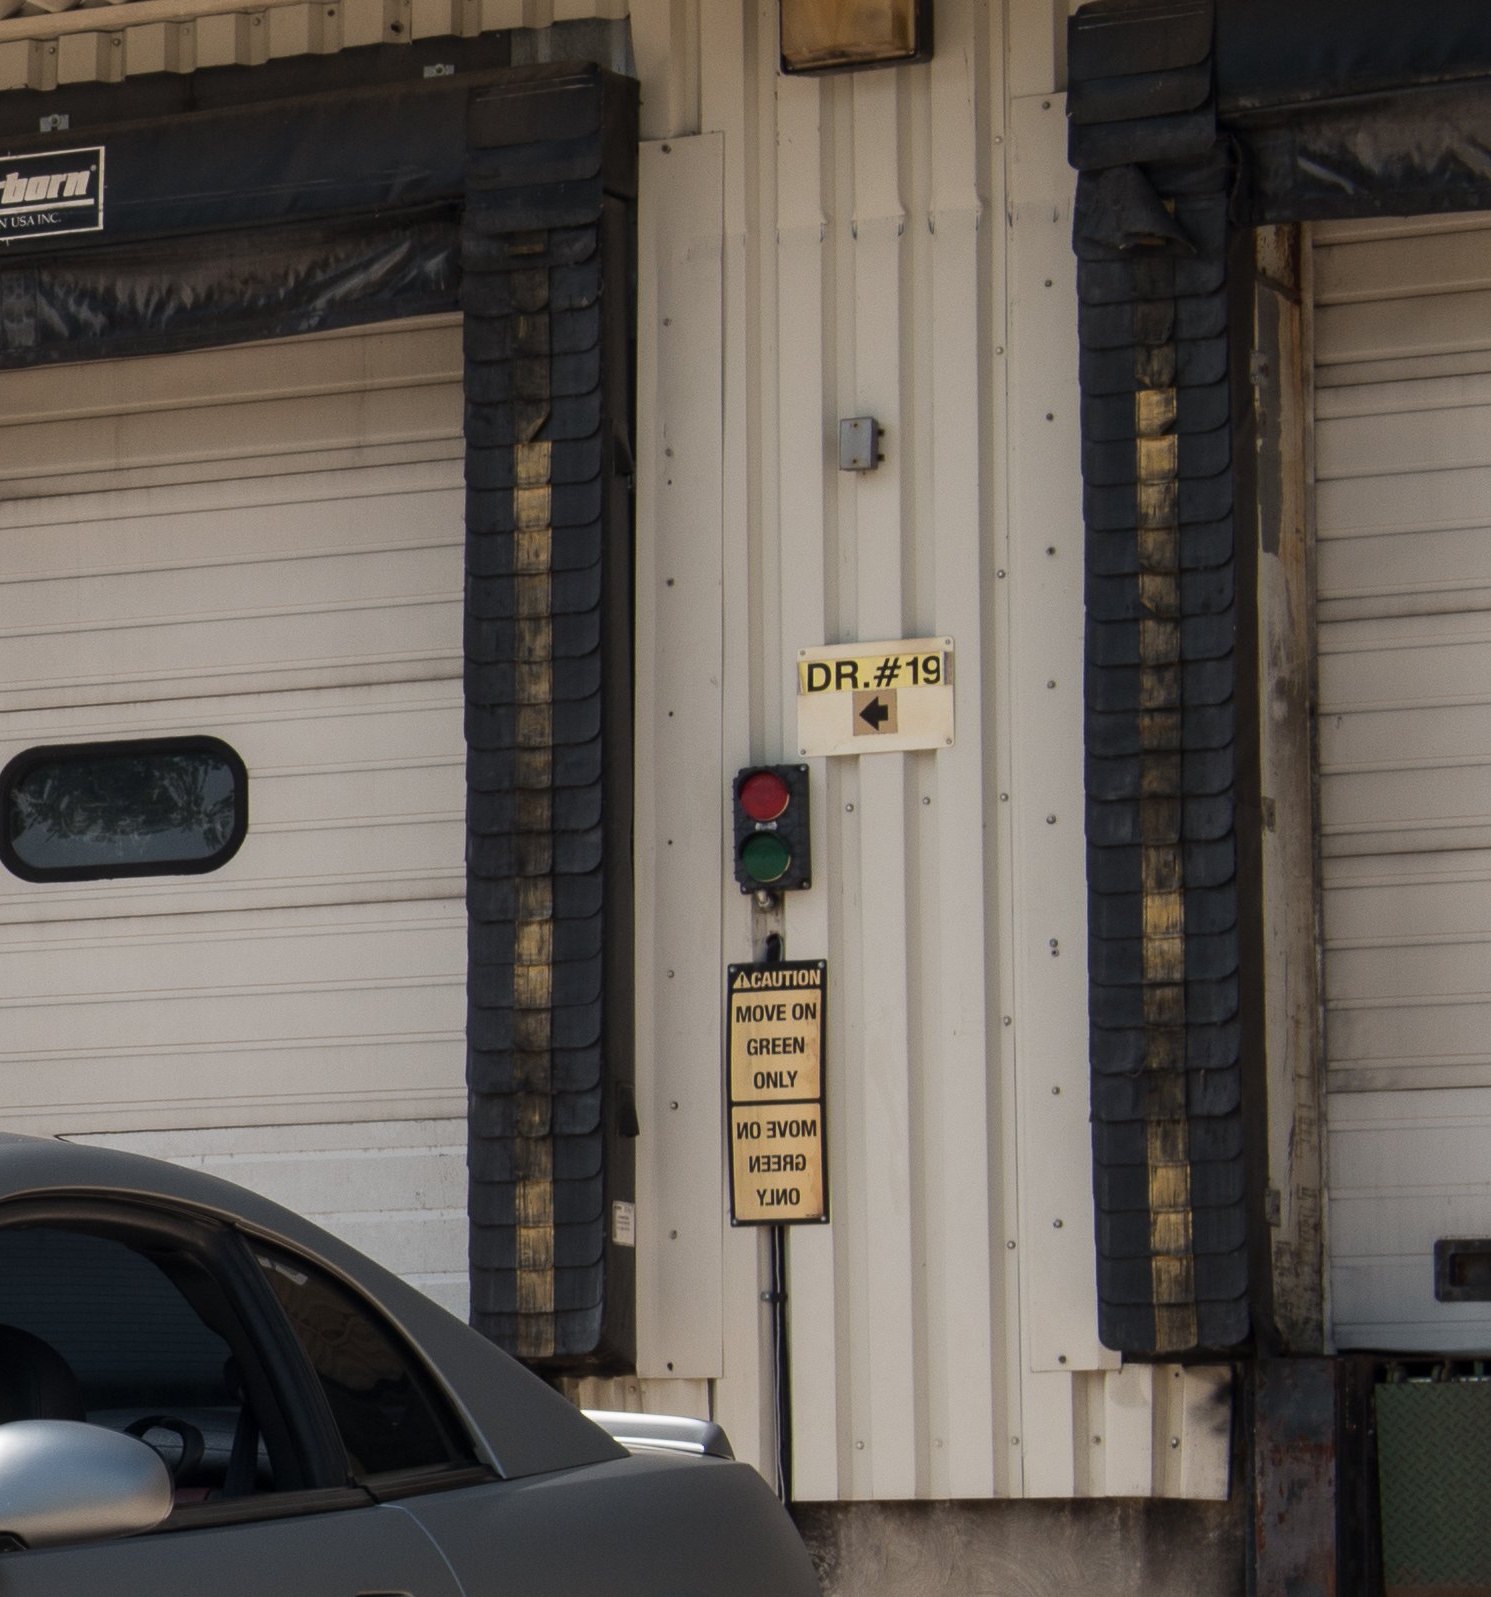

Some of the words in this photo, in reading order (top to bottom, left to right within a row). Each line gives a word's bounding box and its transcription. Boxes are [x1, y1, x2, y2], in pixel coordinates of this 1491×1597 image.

[10, 214, 35, 229] USA
[37, 212, 62, 226] INC.
[807, 655, 941, 692] DR.#19
[751, 969, 820, 988] CAUTION
[736, 1004, 786, 1023] MOVE
[791, 1002, 817, 1020] ON
[747, 1036, 805, 1056] GREEN
[754, 1070, 798, 1089] ONLY
